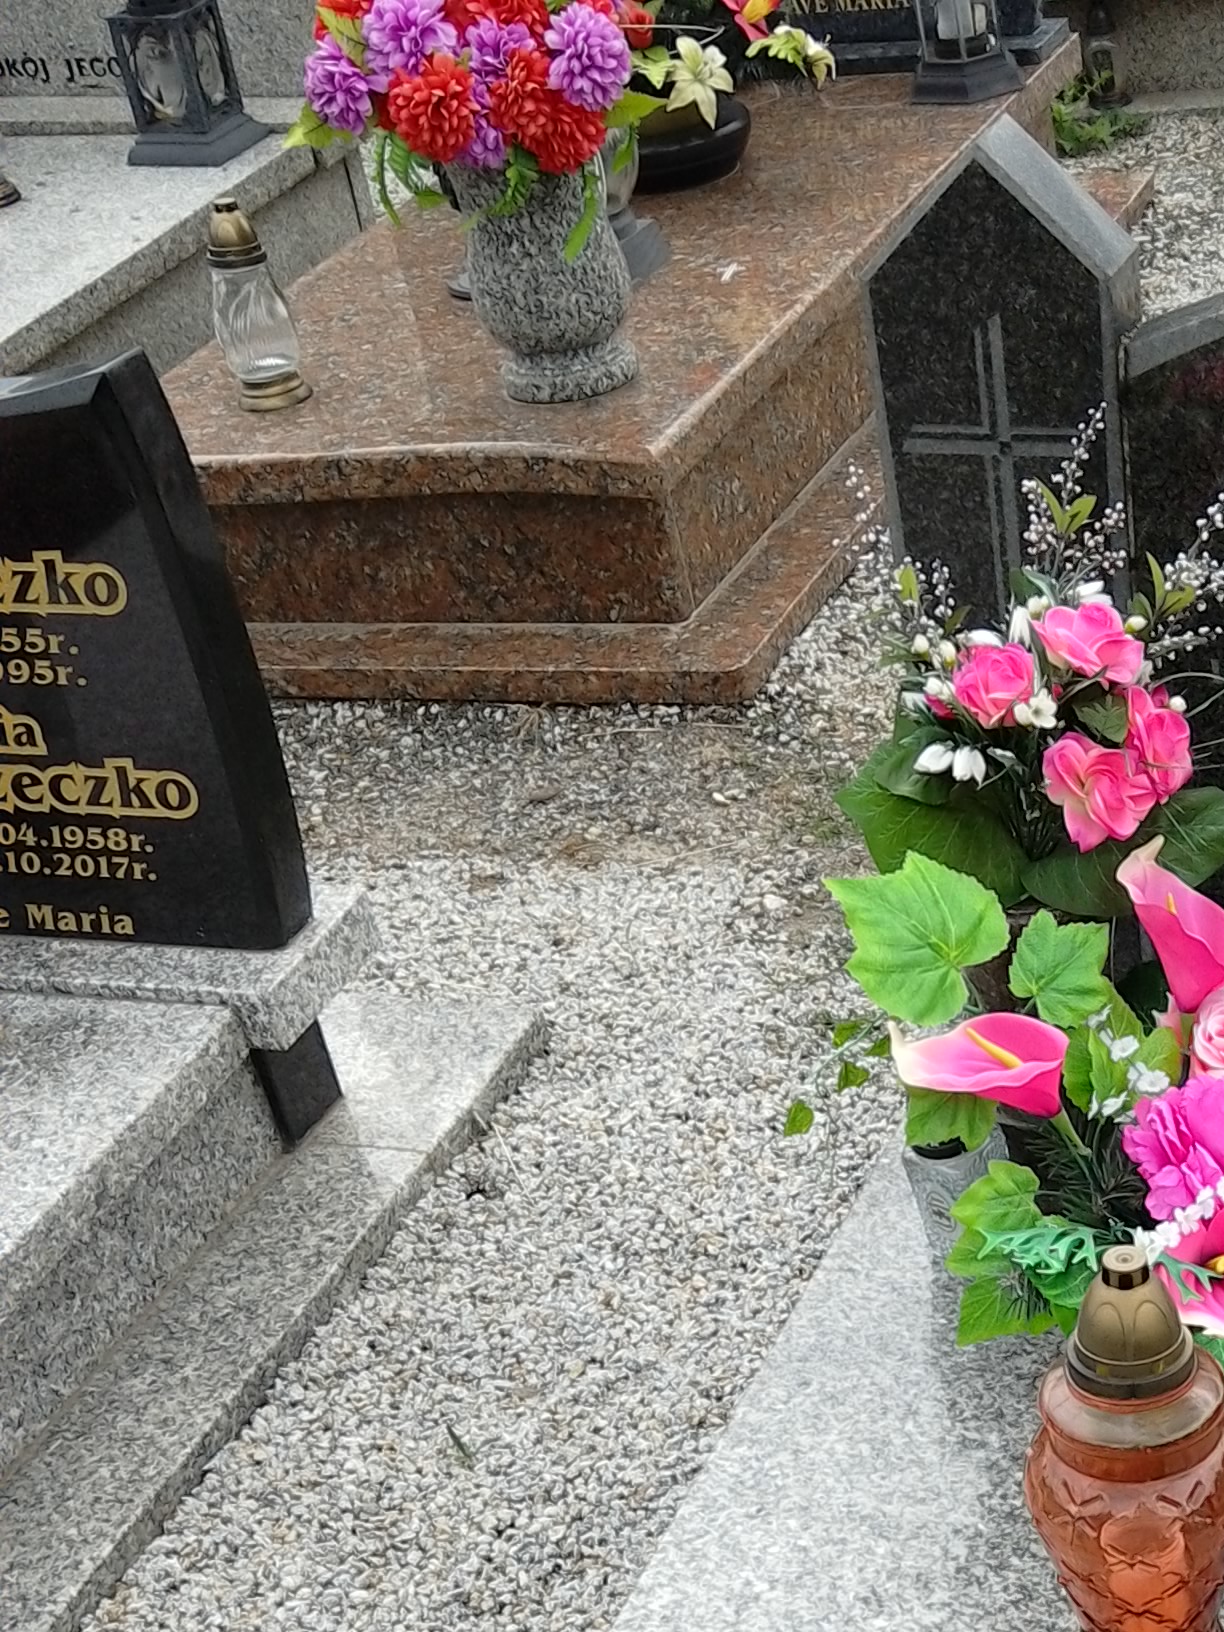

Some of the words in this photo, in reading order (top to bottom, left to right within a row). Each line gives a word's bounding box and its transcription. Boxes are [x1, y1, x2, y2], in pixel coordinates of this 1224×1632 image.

[0, 52, 51, 84] KÓJ
[0, 852, 158, 882] 10.2017r.
[25, 902, 136, 936] Maria
